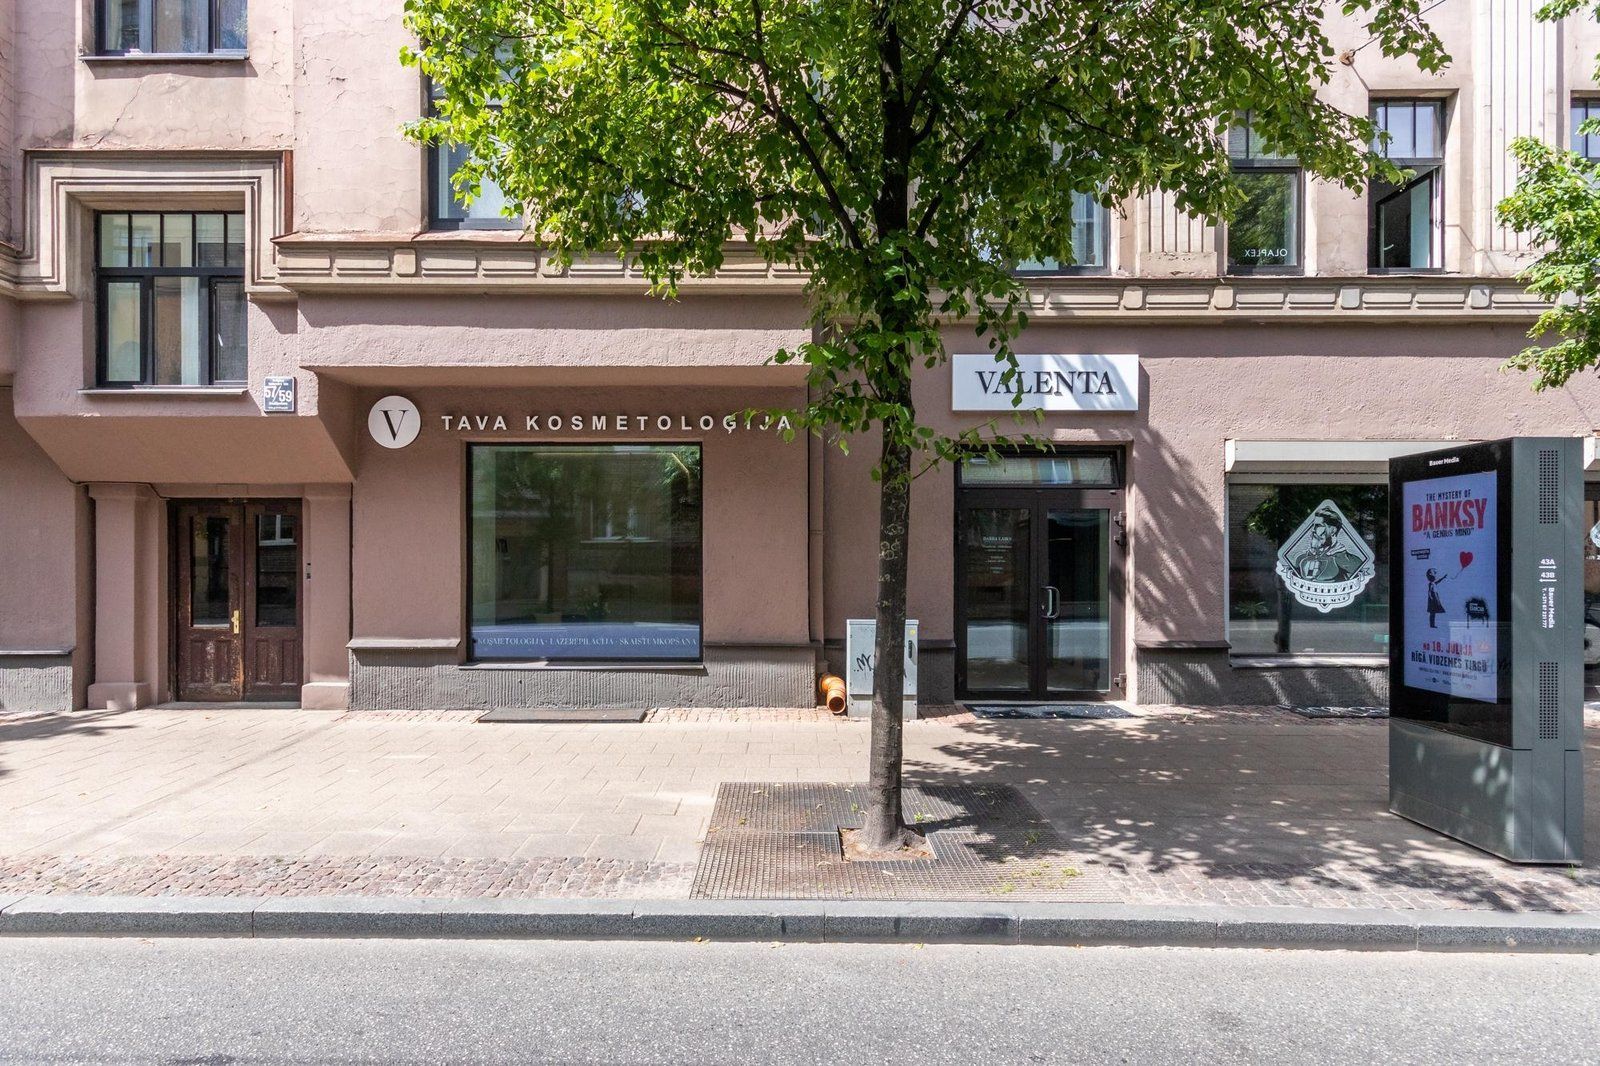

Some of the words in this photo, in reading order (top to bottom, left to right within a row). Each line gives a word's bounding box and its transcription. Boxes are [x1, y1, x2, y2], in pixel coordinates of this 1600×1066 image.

[975, 370, 1117, 395] VALENTA
[378, 409, 408, 442] V
[441, 415, 508, 431] TAVA
[1426, 493, 1436, 501] THE
[1437, 490, 1462, 500] MYSTERY
[1464, 489, 1471, 498] OF
[1412, 498, 1488, 532] BANKSY
[1432, 529, 1453, 539] GENIUS
[1428, 654, 1462, 668] VIDZEMES
